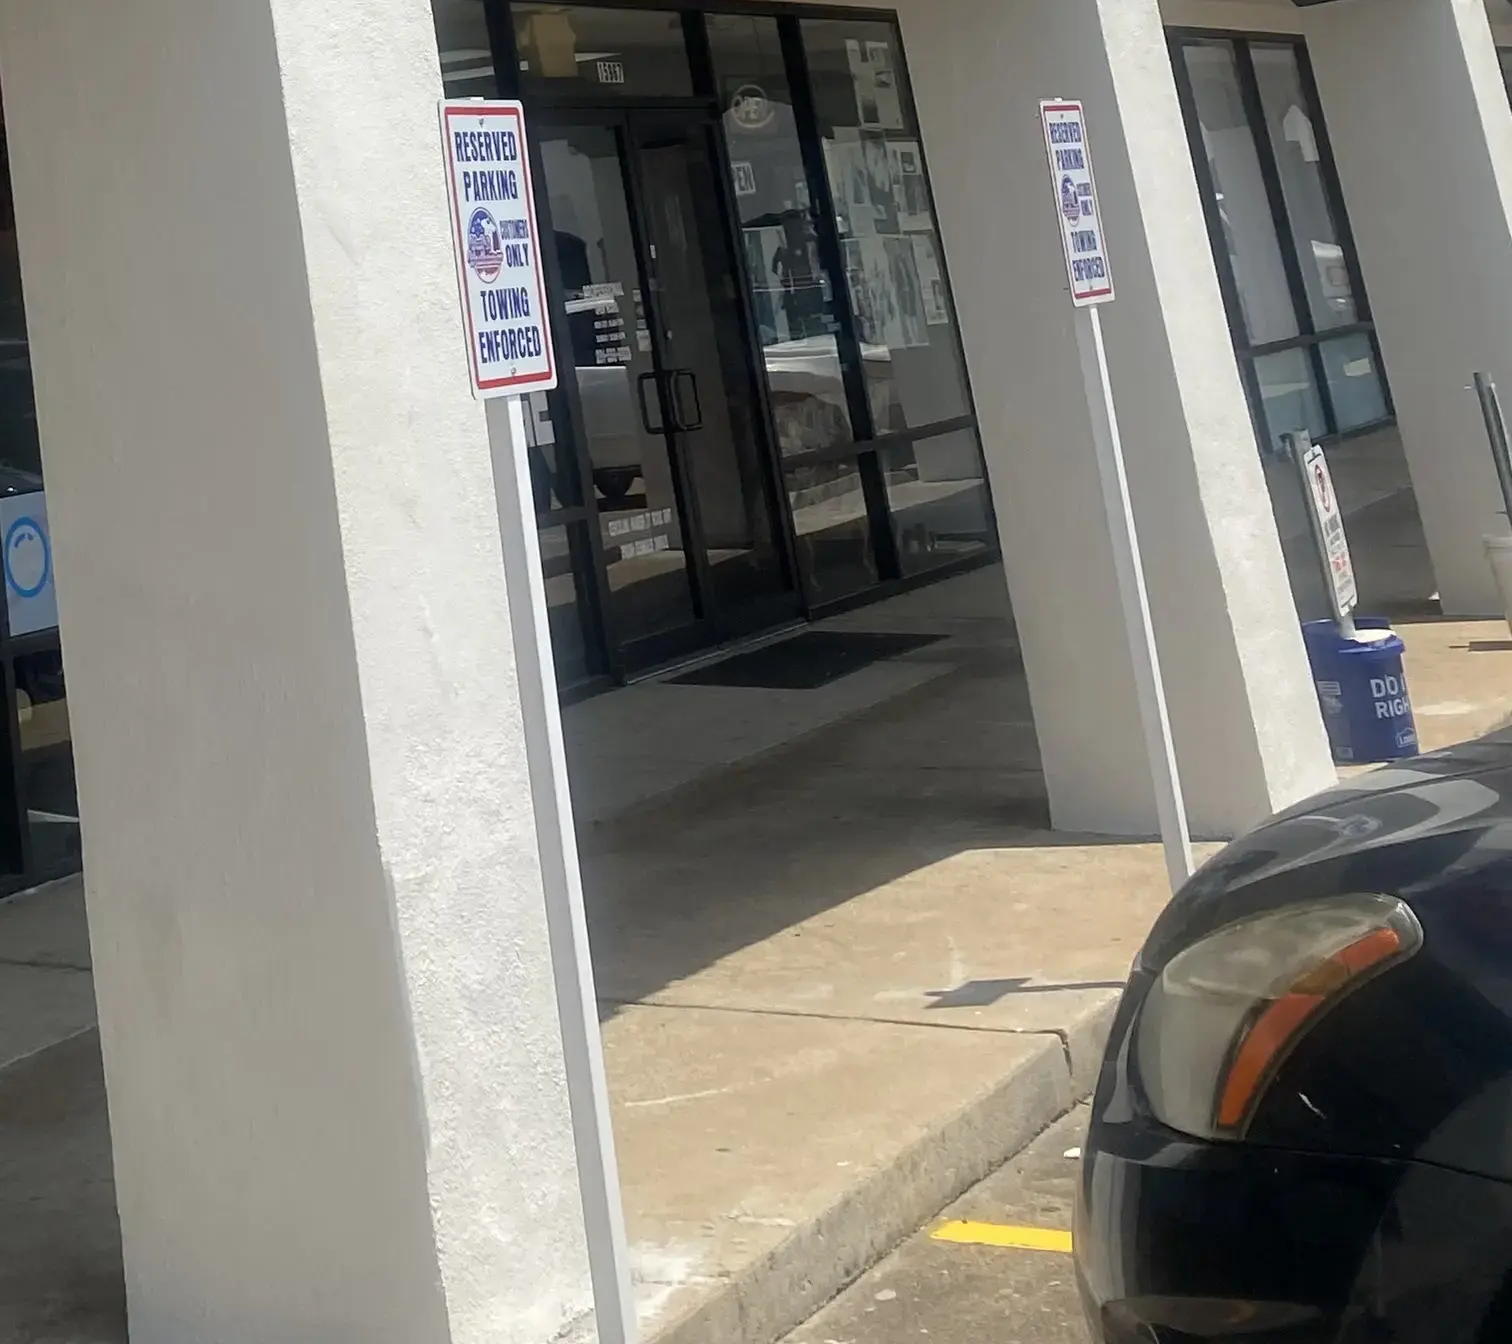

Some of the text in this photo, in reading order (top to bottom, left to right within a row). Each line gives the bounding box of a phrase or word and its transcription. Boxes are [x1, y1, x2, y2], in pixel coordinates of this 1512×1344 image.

[454, 130, 517, 163] RESERVED
[463, 169, 518, 202] PARKING
[505, 243, 529, 268] ONLY
[480, 287, 530, 322] TOWING
[478, 325, 541, 364] ENFORCED
[1369, 673, 1399, 698] DO
